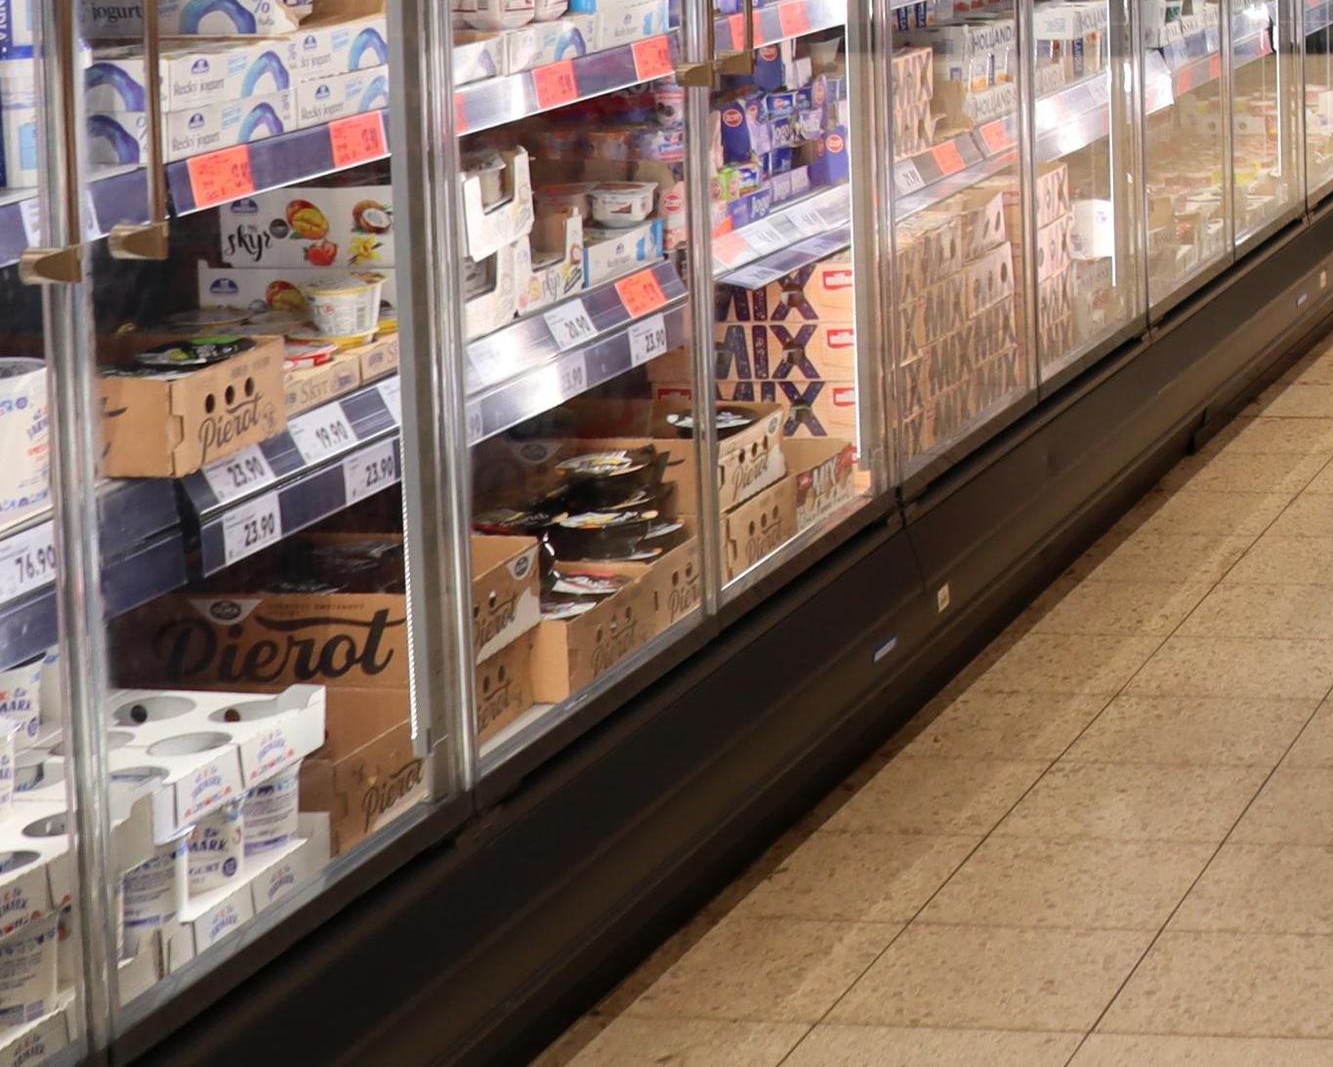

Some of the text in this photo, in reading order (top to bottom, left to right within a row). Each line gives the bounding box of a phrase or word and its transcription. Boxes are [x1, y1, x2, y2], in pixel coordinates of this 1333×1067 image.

[91, 1, 142, 24] jogurt
[198, 390, 263, 464] Pierot
[243, 513, 276, 546] 23.90
[15, 546, 56, 584] 76.90
